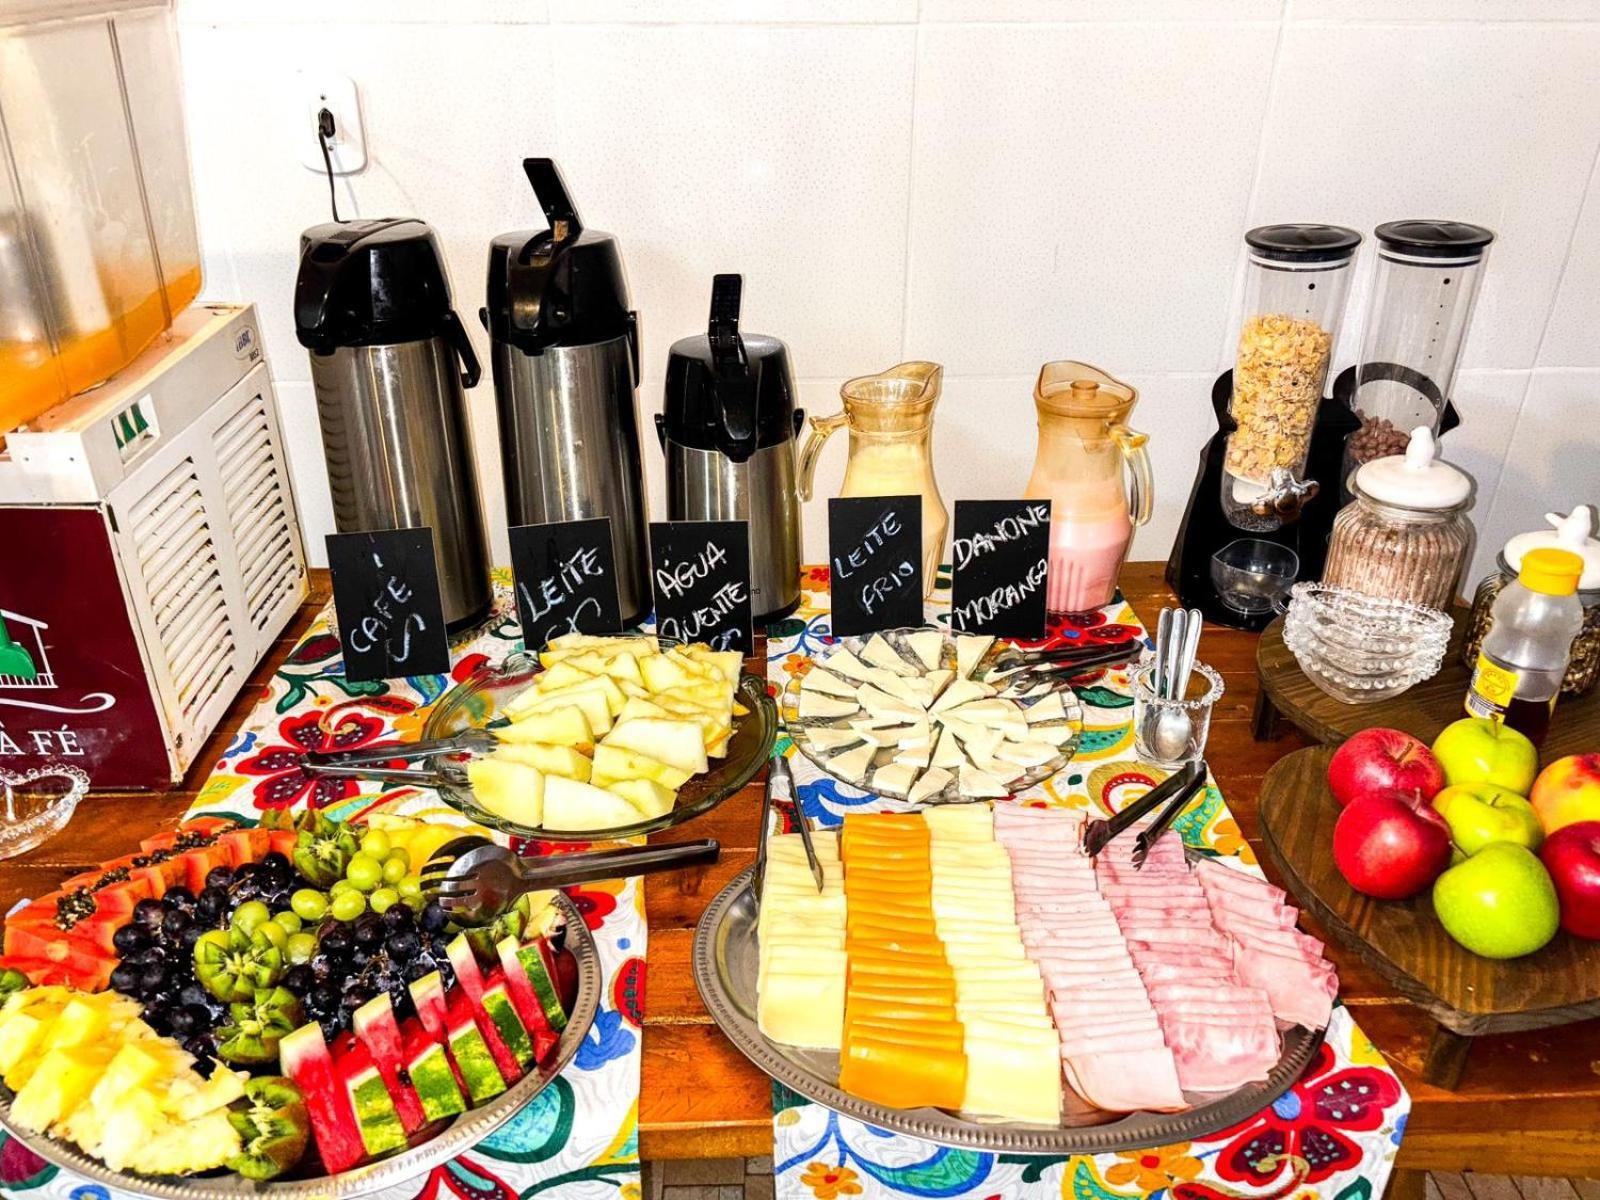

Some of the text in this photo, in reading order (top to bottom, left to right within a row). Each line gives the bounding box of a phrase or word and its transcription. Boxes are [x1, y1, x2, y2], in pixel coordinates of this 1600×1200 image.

[656, 541, 727, 599] ÁGUA
[834, 511, 902, 578] LEITE
[953, 505, 1050, 571] DANONE
[519, 547, 604, 623] LEITE
[660, 581, 748, 647] QUENTE
[862, 561, 914, 615] FRIO
[953, 558, 1048, 631] MORANGO
[27, 724, 85, 756] FÉ
